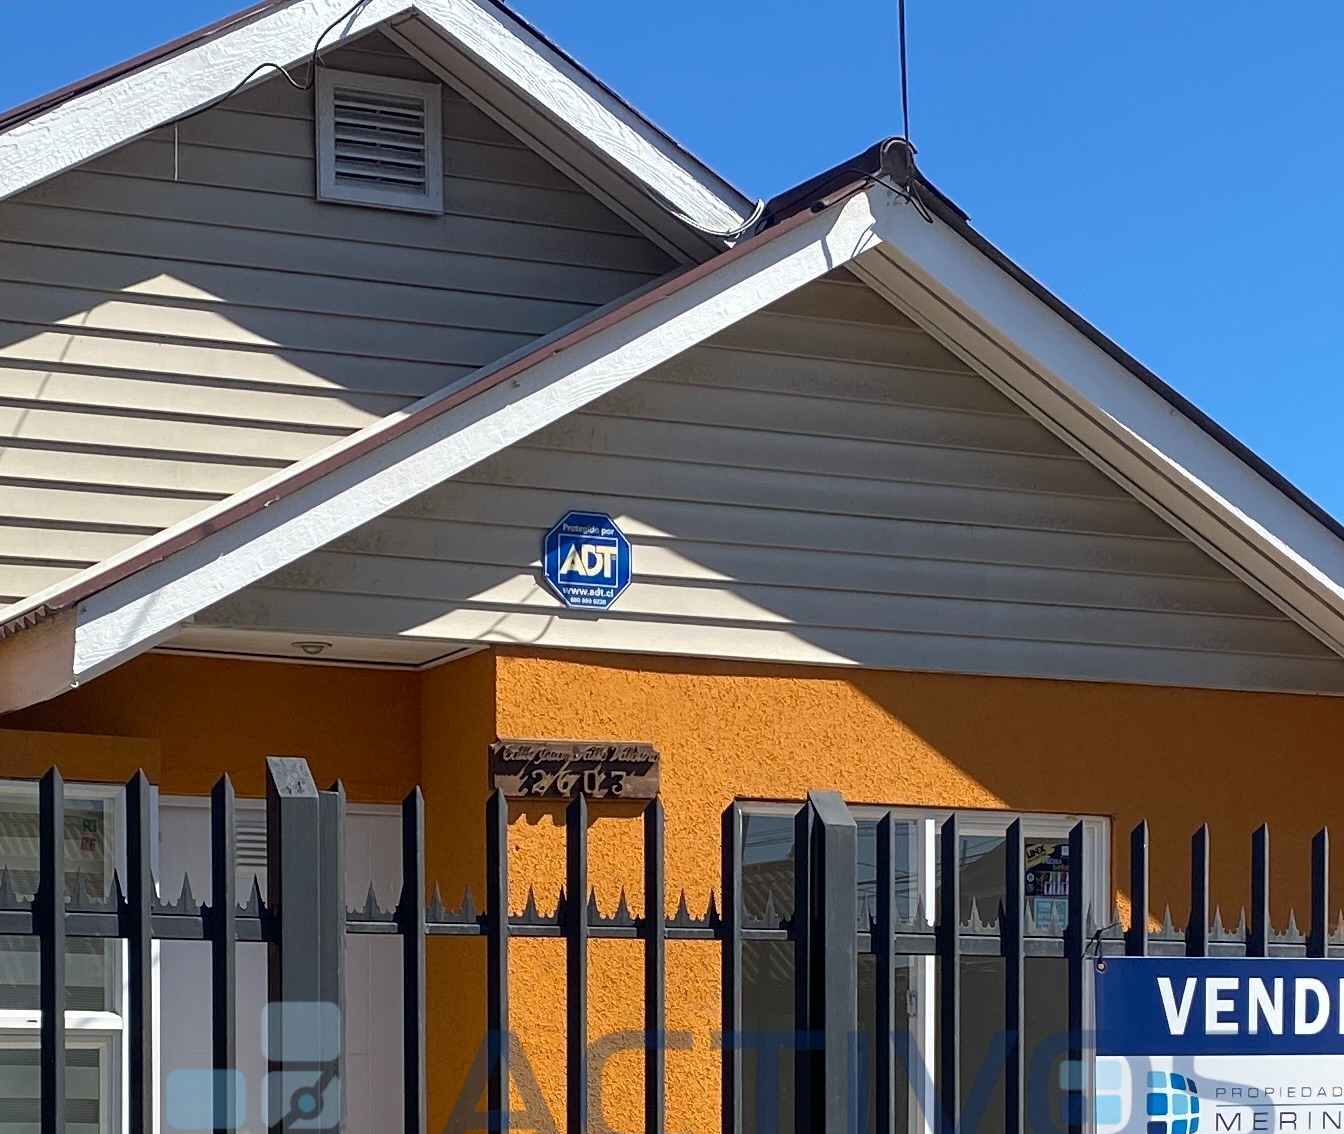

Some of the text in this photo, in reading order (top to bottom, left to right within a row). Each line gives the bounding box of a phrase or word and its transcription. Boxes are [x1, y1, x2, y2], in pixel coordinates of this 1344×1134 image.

[601, 527, 615, 537] por
[559, 543, 617, 578] ADT
[562, 586, 614, 598] www.adt.cl
[531, 769, 626, 795] 2603
